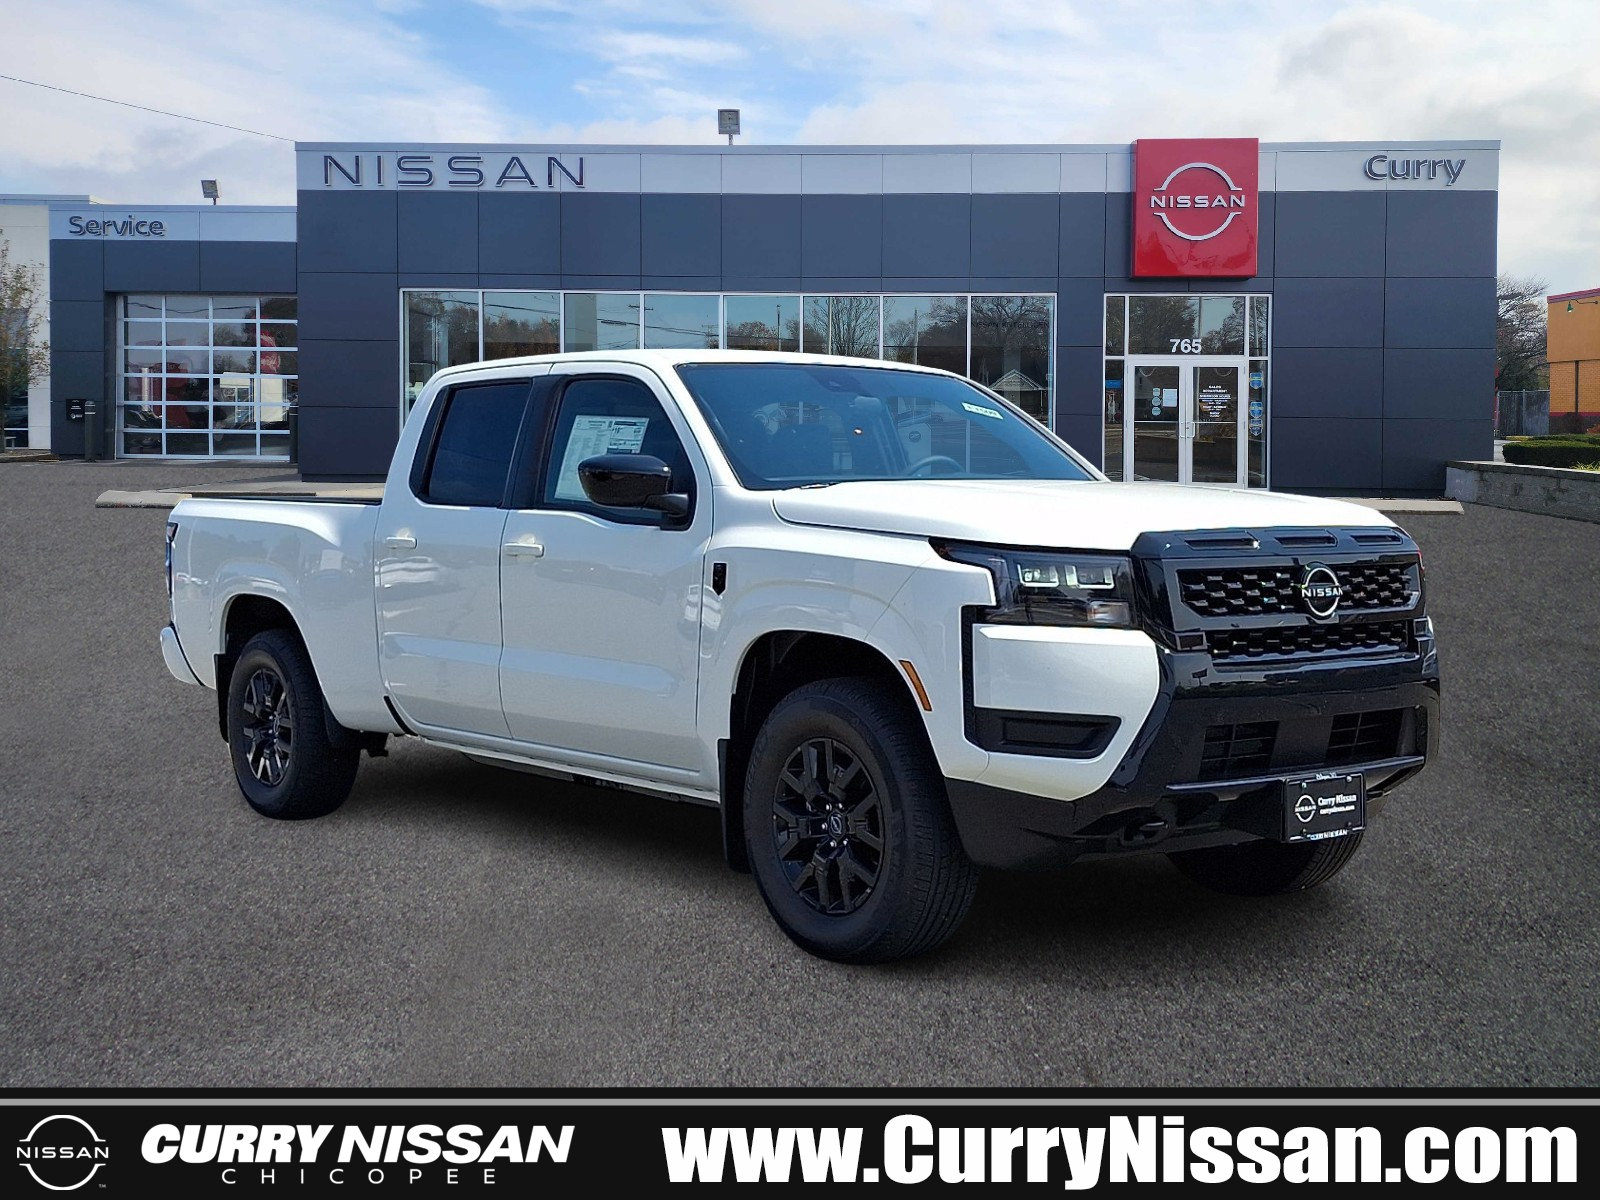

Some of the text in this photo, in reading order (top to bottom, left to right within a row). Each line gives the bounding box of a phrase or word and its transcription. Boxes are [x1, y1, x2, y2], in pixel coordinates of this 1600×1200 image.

[323, 155, 586, 188] NISSAN
[1364, 154, 1466, 186] Curry
[1150, 194, 1245, 208] NISSAN
[69, 214, 165, 236] Service
[1169, 338, 1202, 353] 765
[1301, 587, 1343, 598] NISSAN
[1318, 797, 1335, 806] Curry
